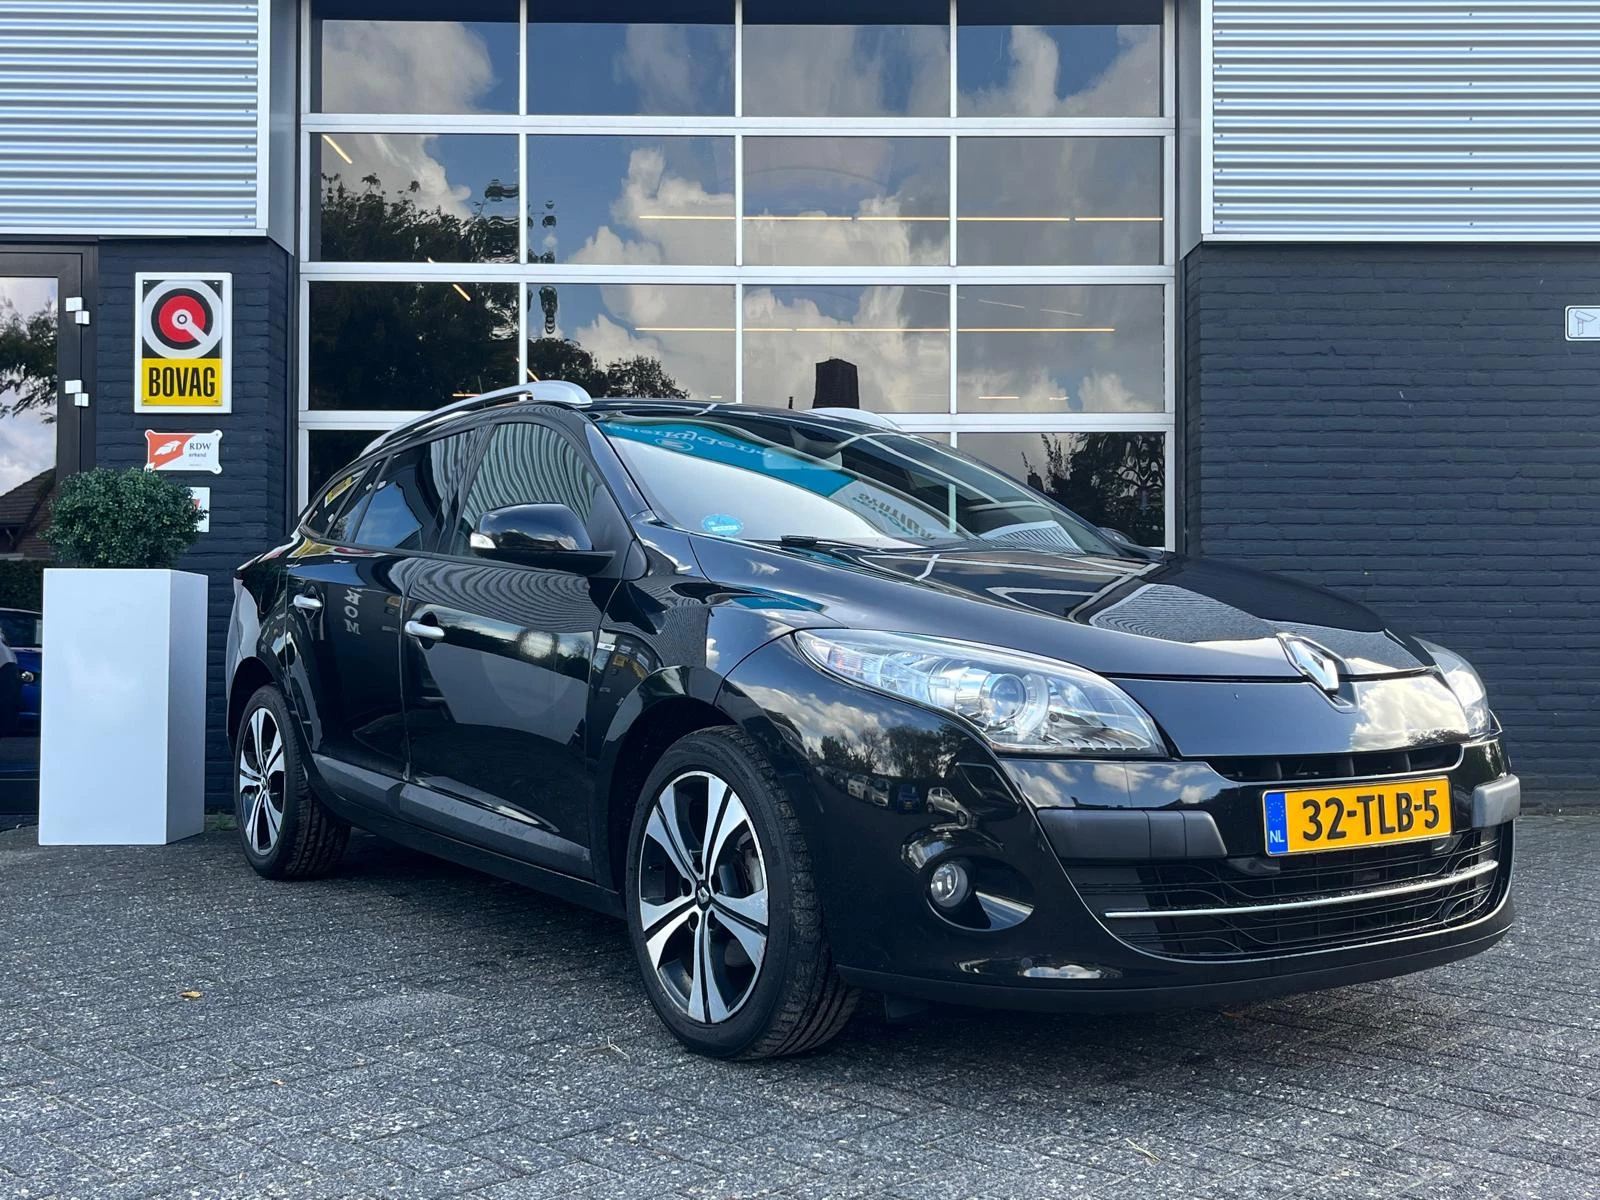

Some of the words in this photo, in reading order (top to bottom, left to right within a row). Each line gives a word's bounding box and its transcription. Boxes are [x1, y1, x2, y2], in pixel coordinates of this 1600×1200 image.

[149, 367, 215, 397] BOVAG
[189, 442, 211, 450] RDW
[1302, 789, 1440, 841] 32-TLB-5
[1270, 830, 1285, 843] NL
